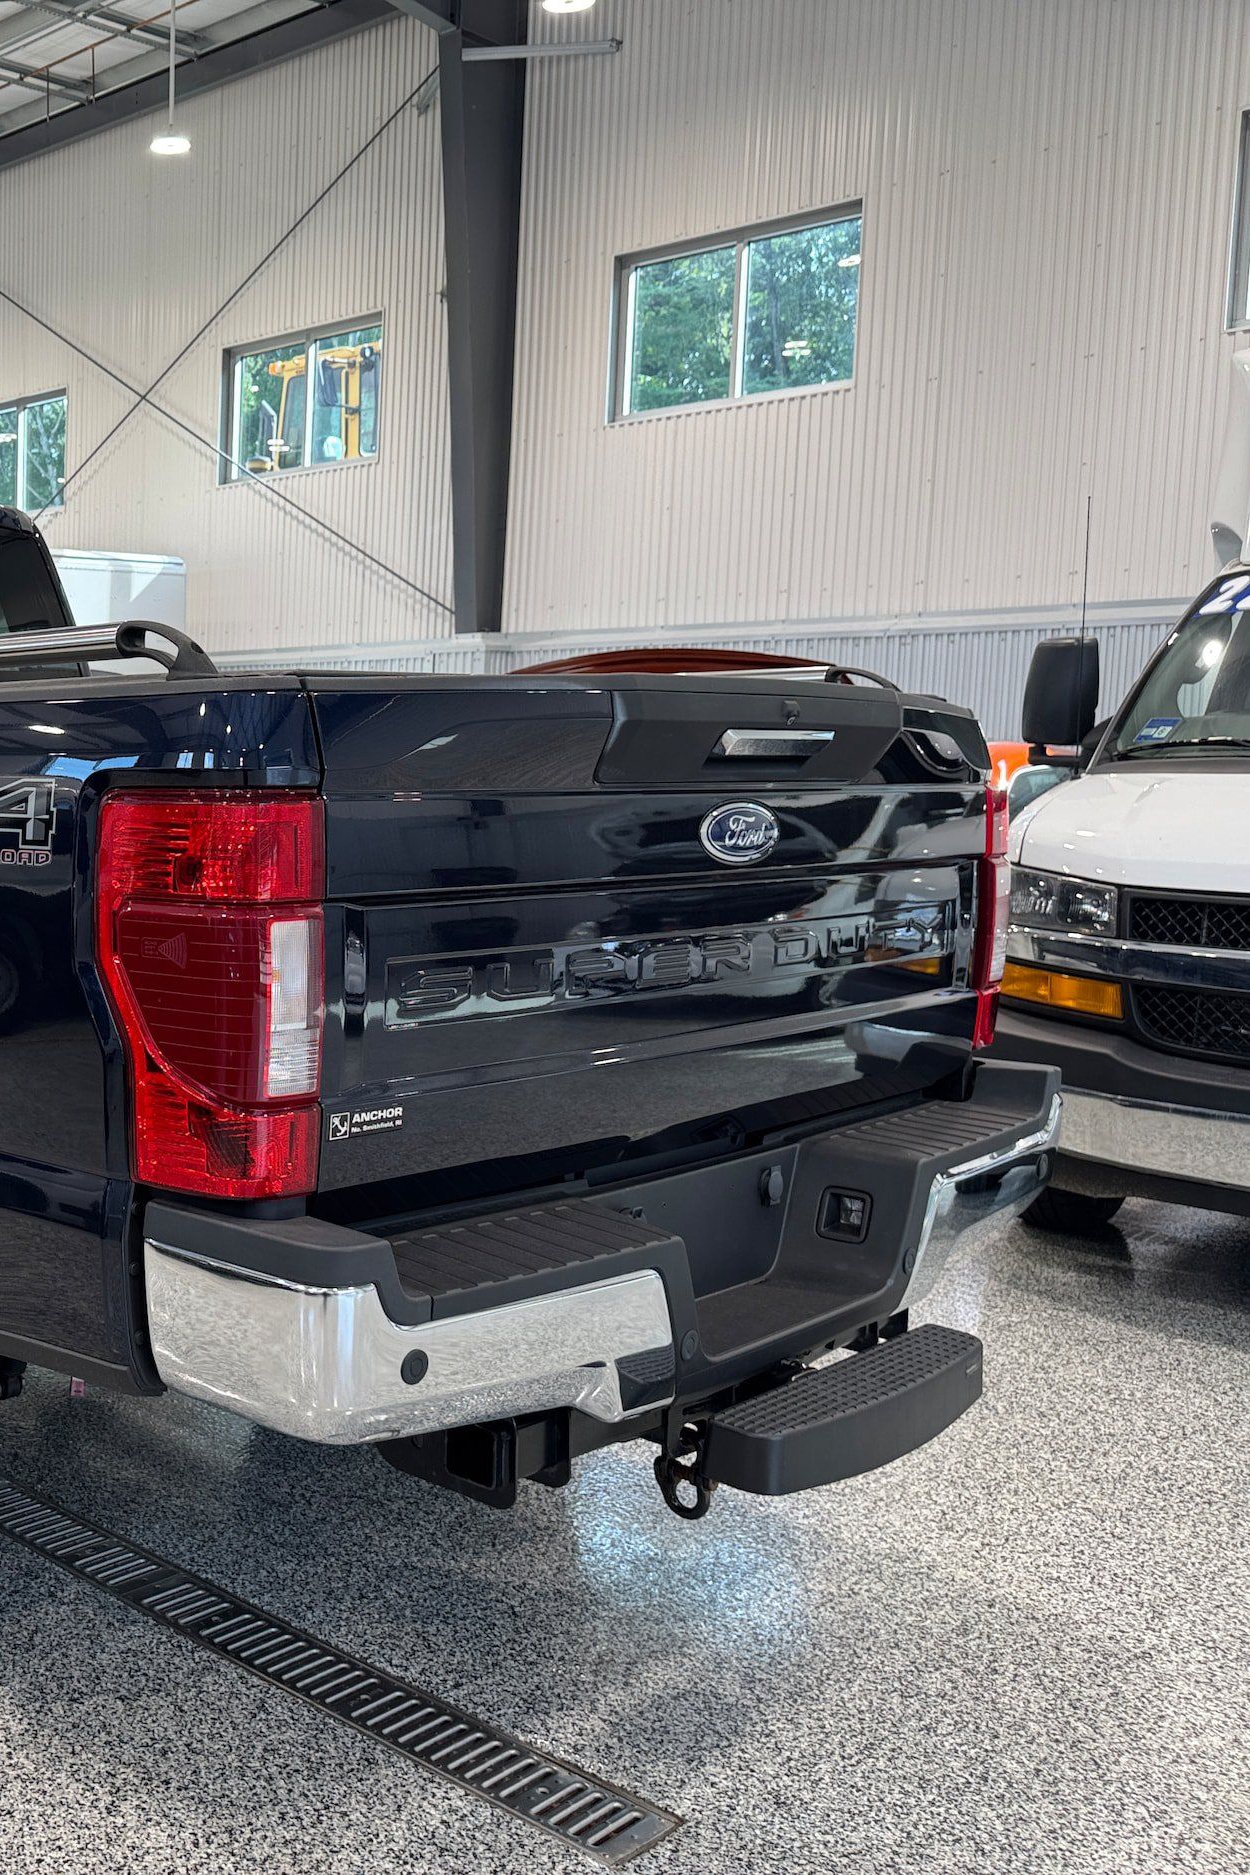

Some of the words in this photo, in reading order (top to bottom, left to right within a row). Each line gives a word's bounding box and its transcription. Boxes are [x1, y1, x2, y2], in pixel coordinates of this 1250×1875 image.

[724, 815, 767, 847] Ford
[397, 932, 751, 1015] SUPER
[773, 913, 946, 967] DUTY
[351, 1107, 403, 1123] ANCHOR
